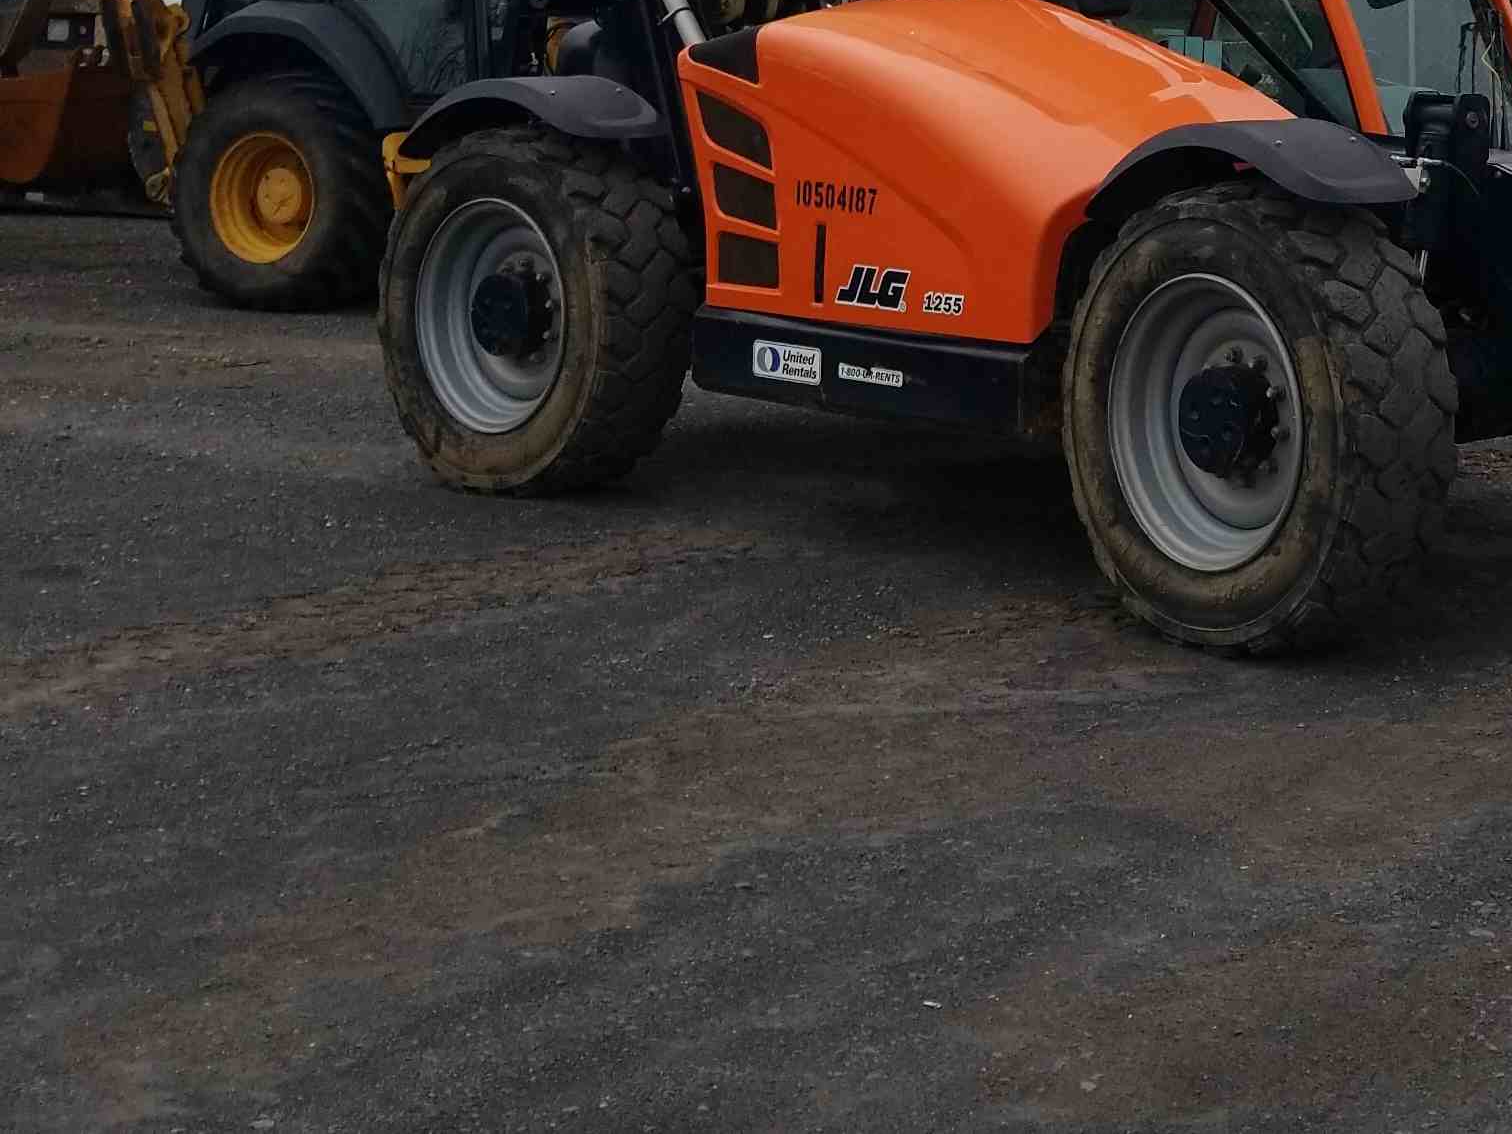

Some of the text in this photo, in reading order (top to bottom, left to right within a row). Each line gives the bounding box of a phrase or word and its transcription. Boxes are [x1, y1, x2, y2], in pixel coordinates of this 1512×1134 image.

[796, 179, 878, 215] 10504187
[836, 265, 911, 311] JLG
[923, 292, 964, 315] 1255
[782, 350, 816, 366] United
[782, 363, 818, 380] Rentals
